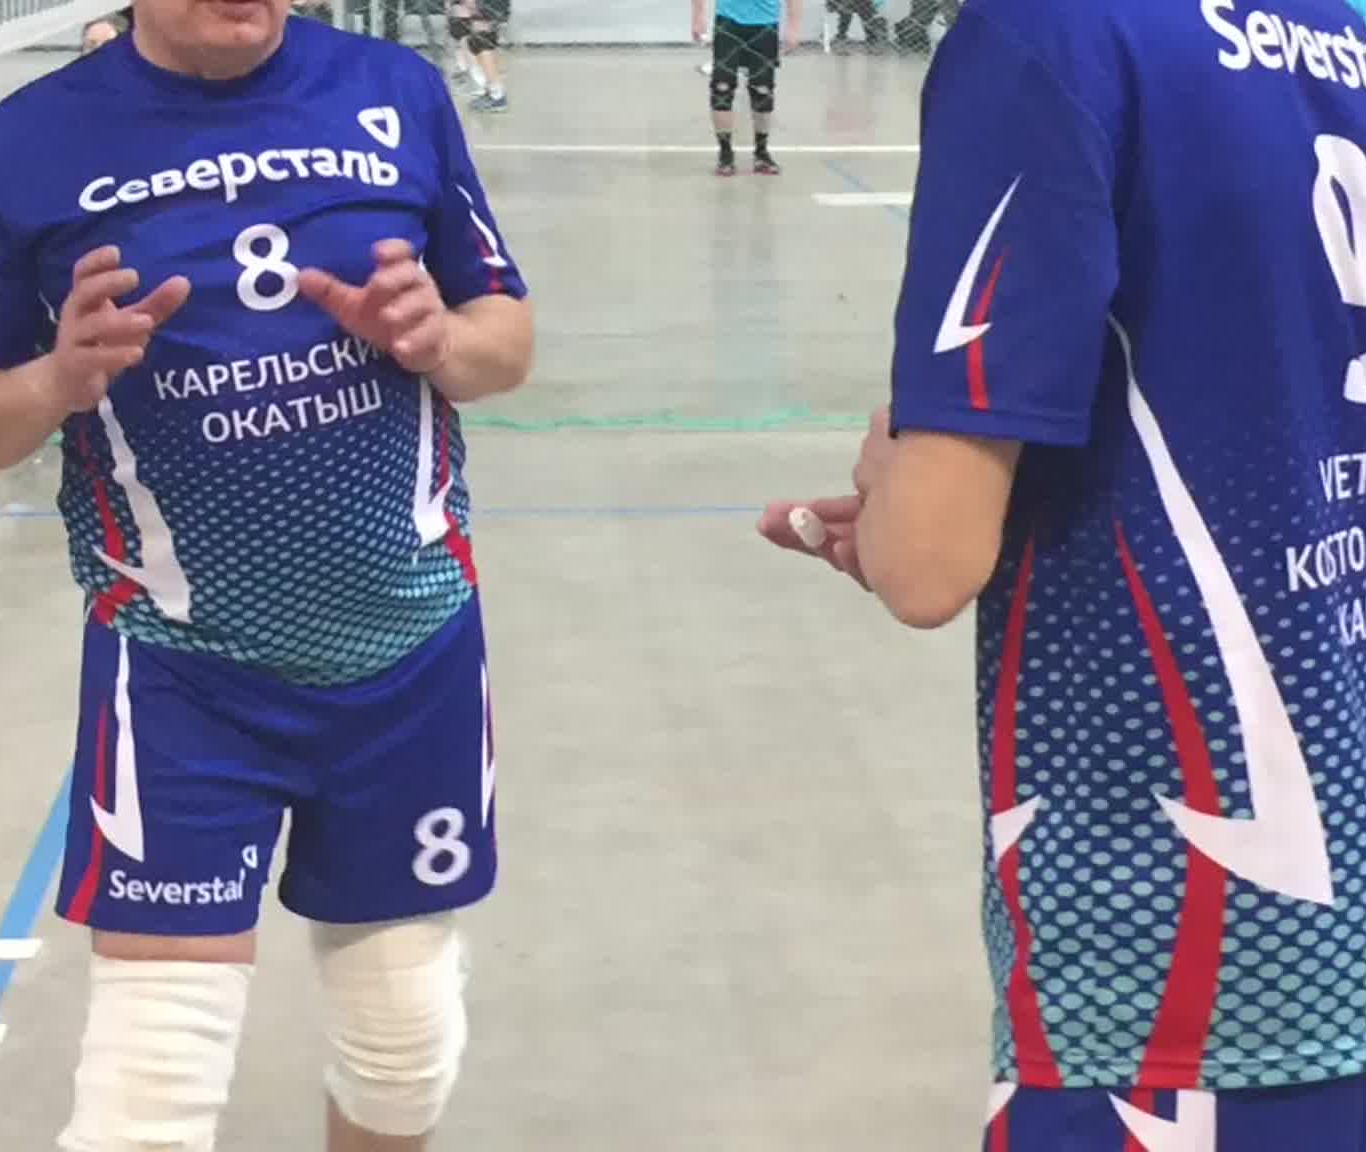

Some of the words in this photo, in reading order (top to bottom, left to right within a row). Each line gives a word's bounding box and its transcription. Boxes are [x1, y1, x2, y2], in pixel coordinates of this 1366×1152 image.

[78, 146, 401, 212] Северсталь
[233, 223, 300, 311] 8
[153, 336, 381, 400] КАРЕЛЬСКИ
[202, 379, 383, 443] ОКАТЫШ
[412, 807, 471, 886] 8
[108, 867, 246, 905] Severstal
